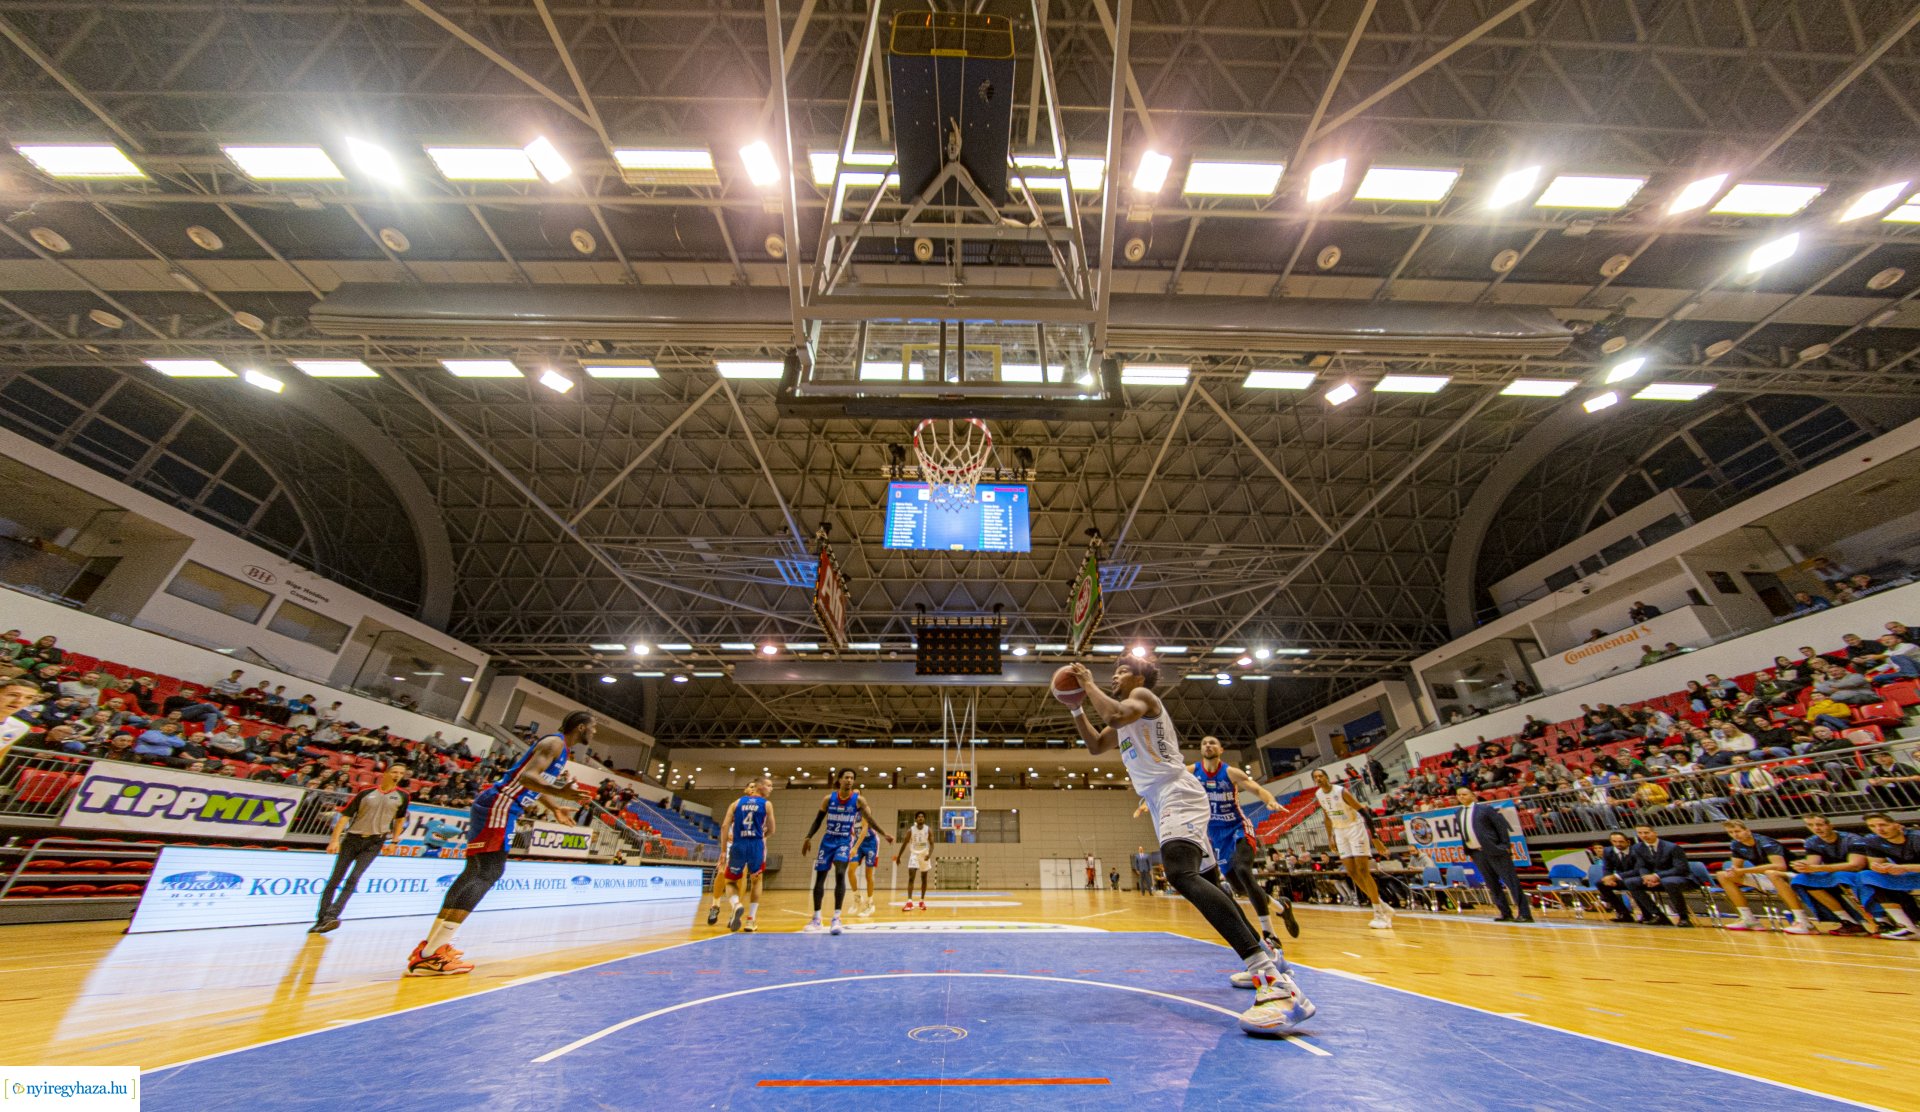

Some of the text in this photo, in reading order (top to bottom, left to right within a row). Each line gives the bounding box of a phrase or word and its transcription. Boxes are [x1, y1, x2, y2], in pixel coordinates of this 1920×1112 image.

[248, 567, 272, 583] BH
[1563, 629, 1640, 665] Continental
[1211, 802, 1217, 814] 7
[742, 812, 754, 830] 4
[834, 822, 841, 832] 2
[818, 850, 825, 860] 2
[1214, 848, 1220, 860] 7
[157, 880, 242, 891] KORONA
[365, 878, 430, 894] HOTEL
[490, 878, 530, 891] RONA
[533, 878, 567, 890] HOTEL
[593, 878, 626, 889] KORONA
[627, 878, 648, 888] HOTEL
